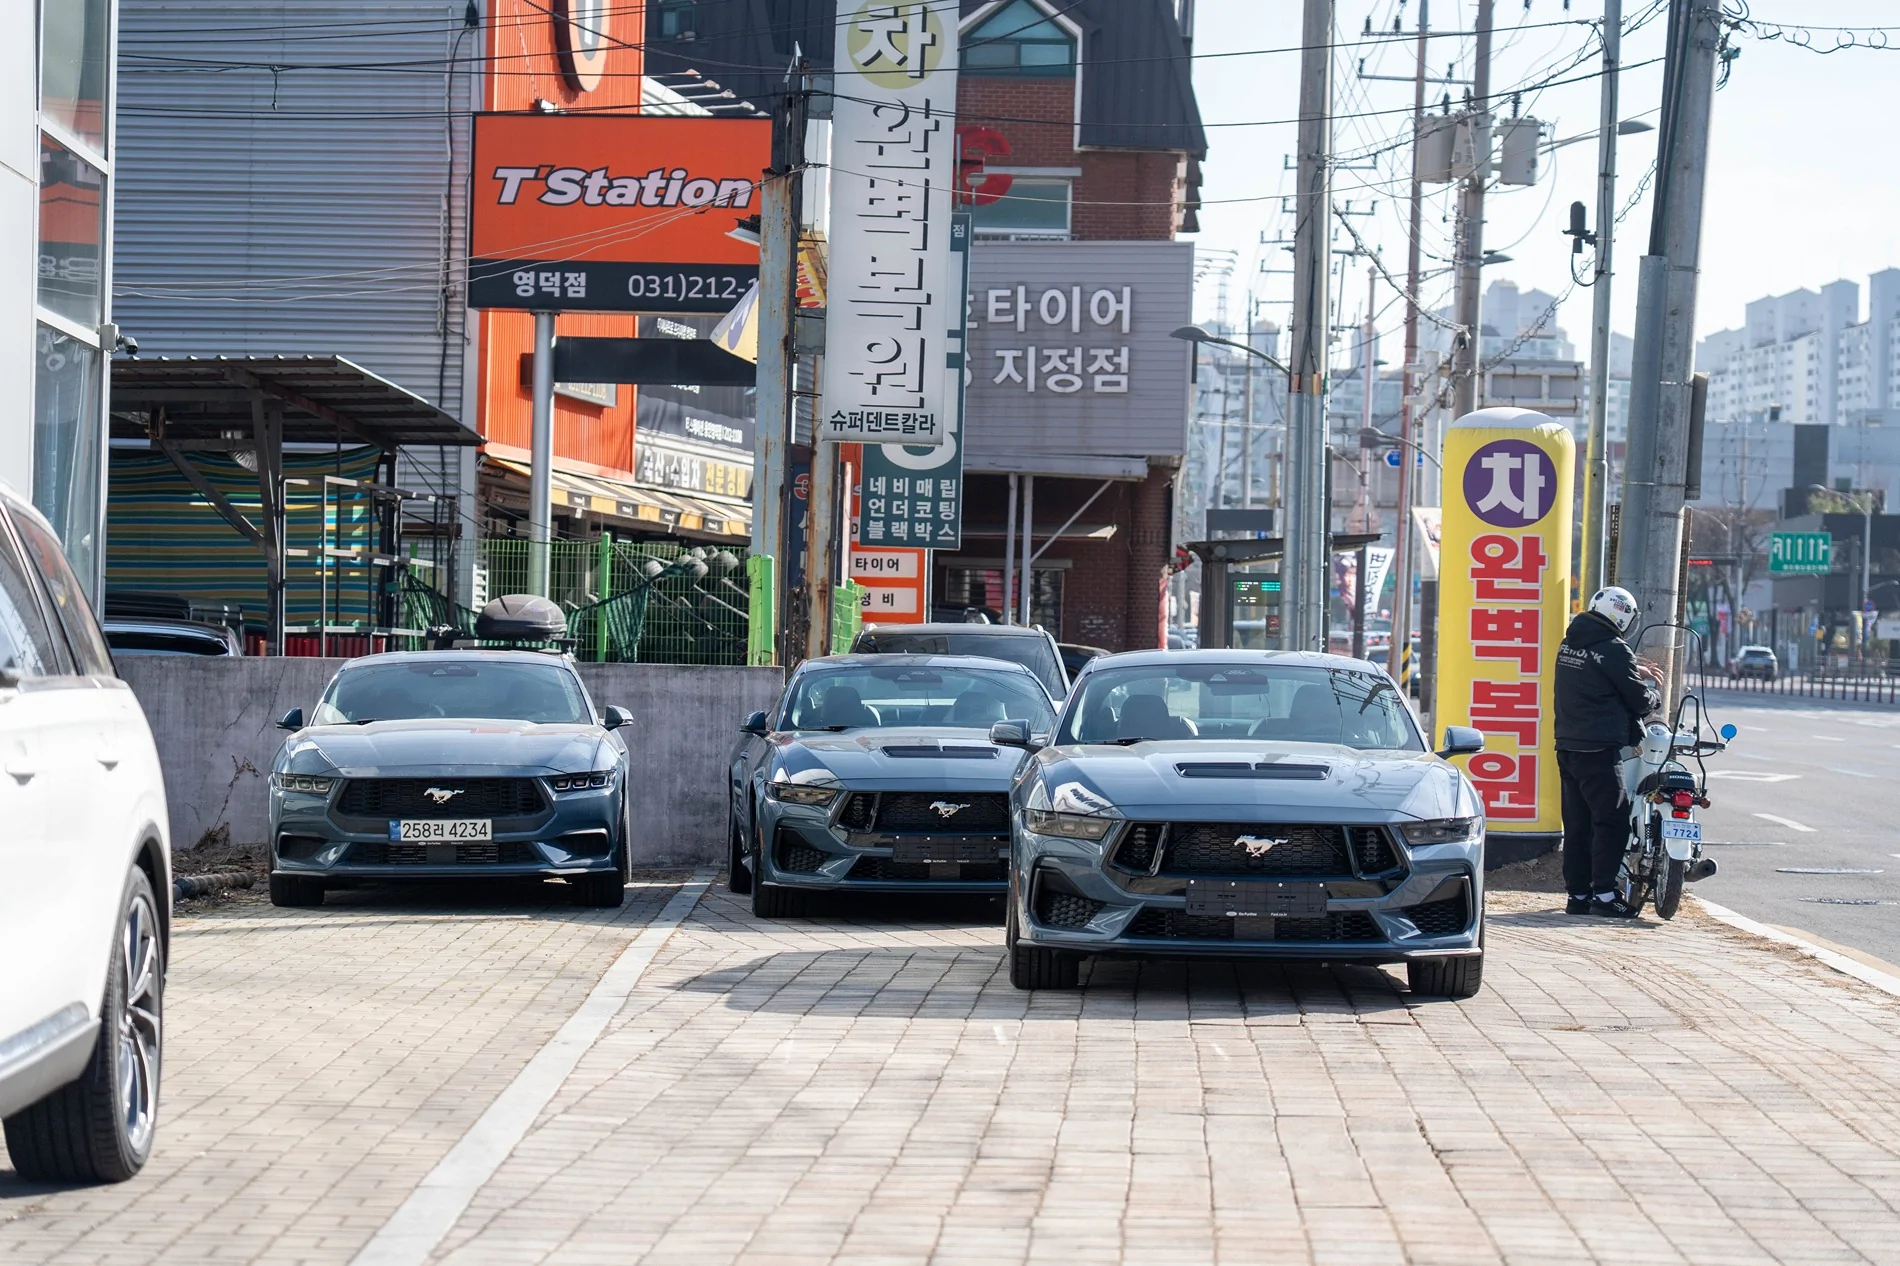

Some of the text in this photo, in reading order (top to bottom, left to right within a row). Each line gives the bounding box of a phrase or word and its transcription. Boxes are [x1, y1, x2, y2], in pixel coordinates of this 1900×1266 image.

[853, 4, 937, 80] 차
[847, 97, 941, 410] 완벽복원
[512, 271, 588, 299] 영덕점
[993, 346, 1131, 394] 지정점
[829, 410, 936, 436] 슈퍼덴트칼라
[869, 476, 957, 499] 네비매립
[1476, 452, 1546, 520] 차
[868, 499, 956, 521] 언더코팅
[866, 521, 956, 542] 블랙박스
[855, 557, 900, 572] 타이어
[1468, 533, 1548, 821] 완벽복원
[402, 822, 488, 838] 258러 4234
[1673, 828, 1699, 838] 7724
